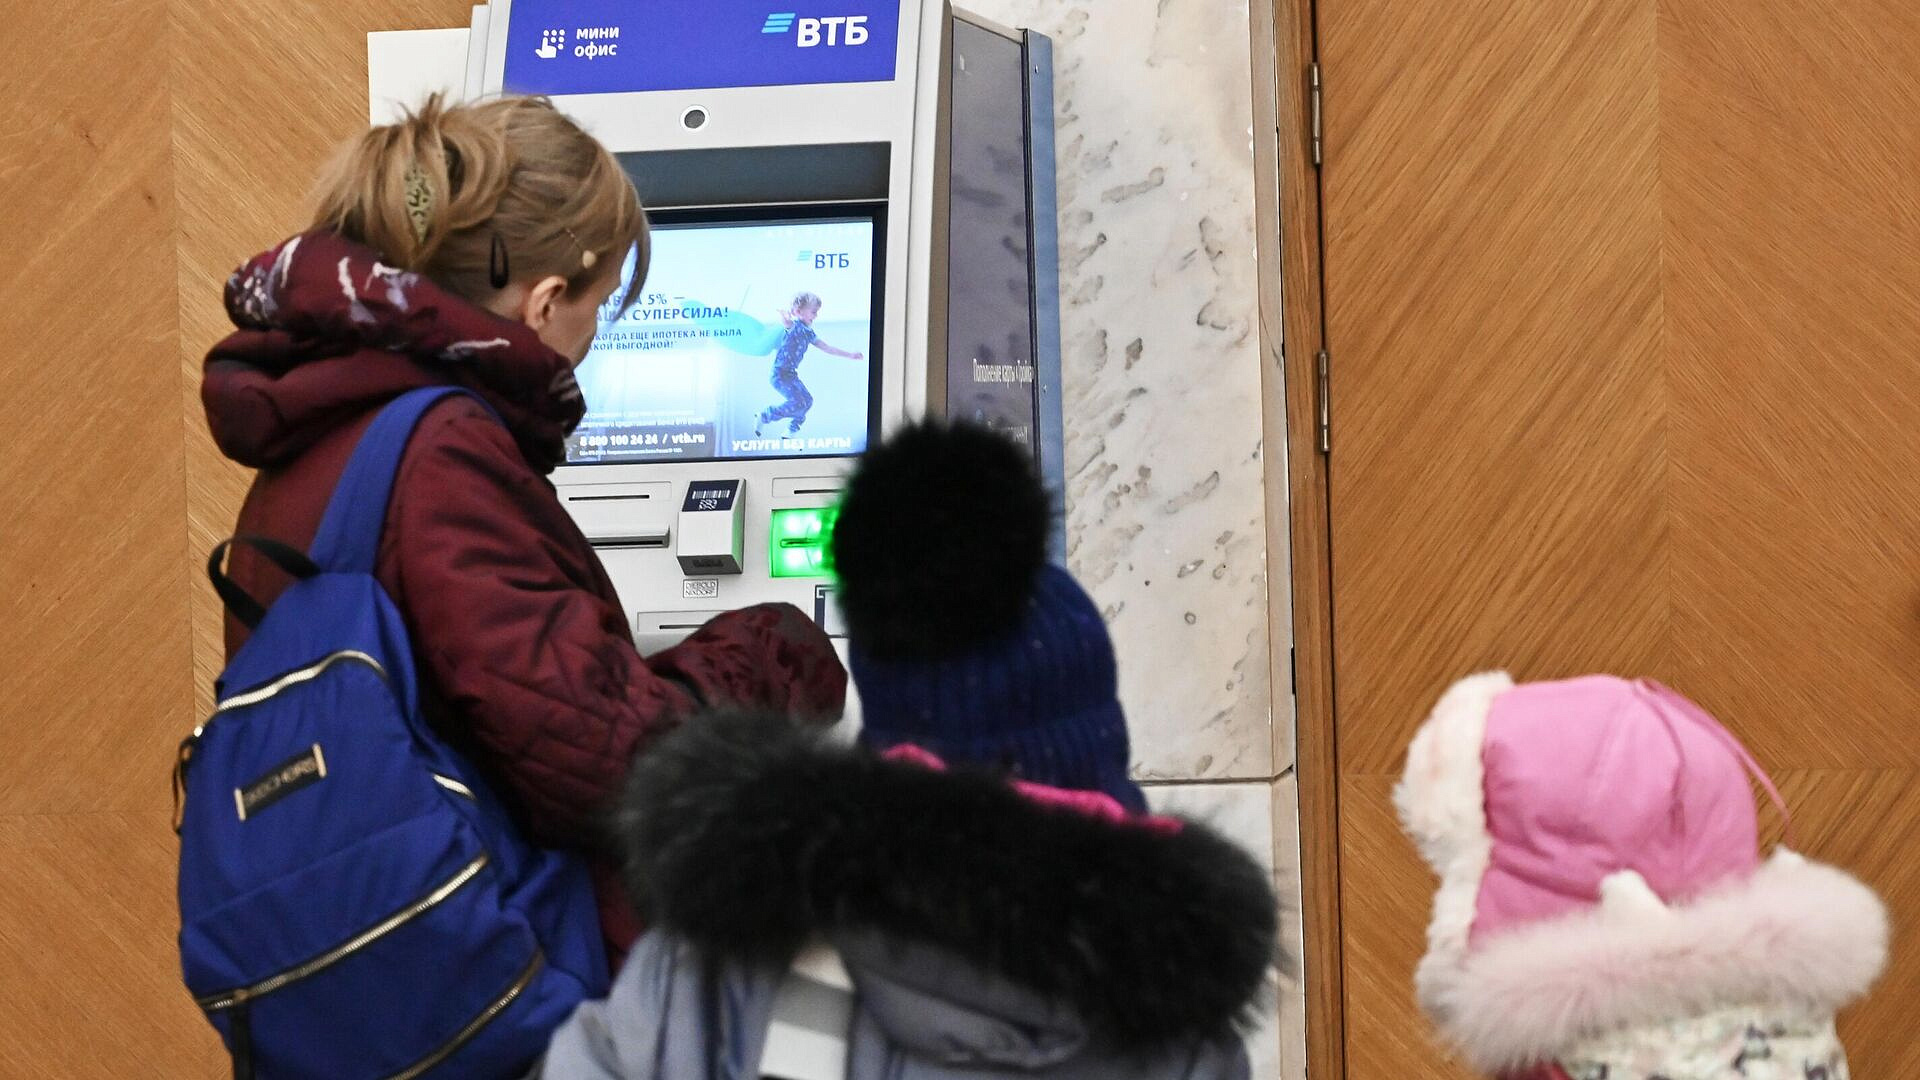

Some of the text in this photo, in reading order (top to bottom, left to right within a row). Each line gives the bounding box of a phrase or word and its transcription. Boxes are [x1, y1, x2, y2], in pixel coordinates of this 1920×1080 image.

[797, 15, 869, 48] ВТБ
[814, 253, 849, 269] ВТБ
[648, 293, 667, 305] 5%
[632, 307, 728, 320] СУПЕРСИЛА!
[652, 329, 696, 339] ИПОТЕКА
[713, 328, 743, 337] БЫЛА
[579, 435, 587, 446] 8
[610, 434, 629, 445] 100
[731, 439, 781, 452] УСЛУГИ
[807, 436, 851, 449] КАРТЫ
